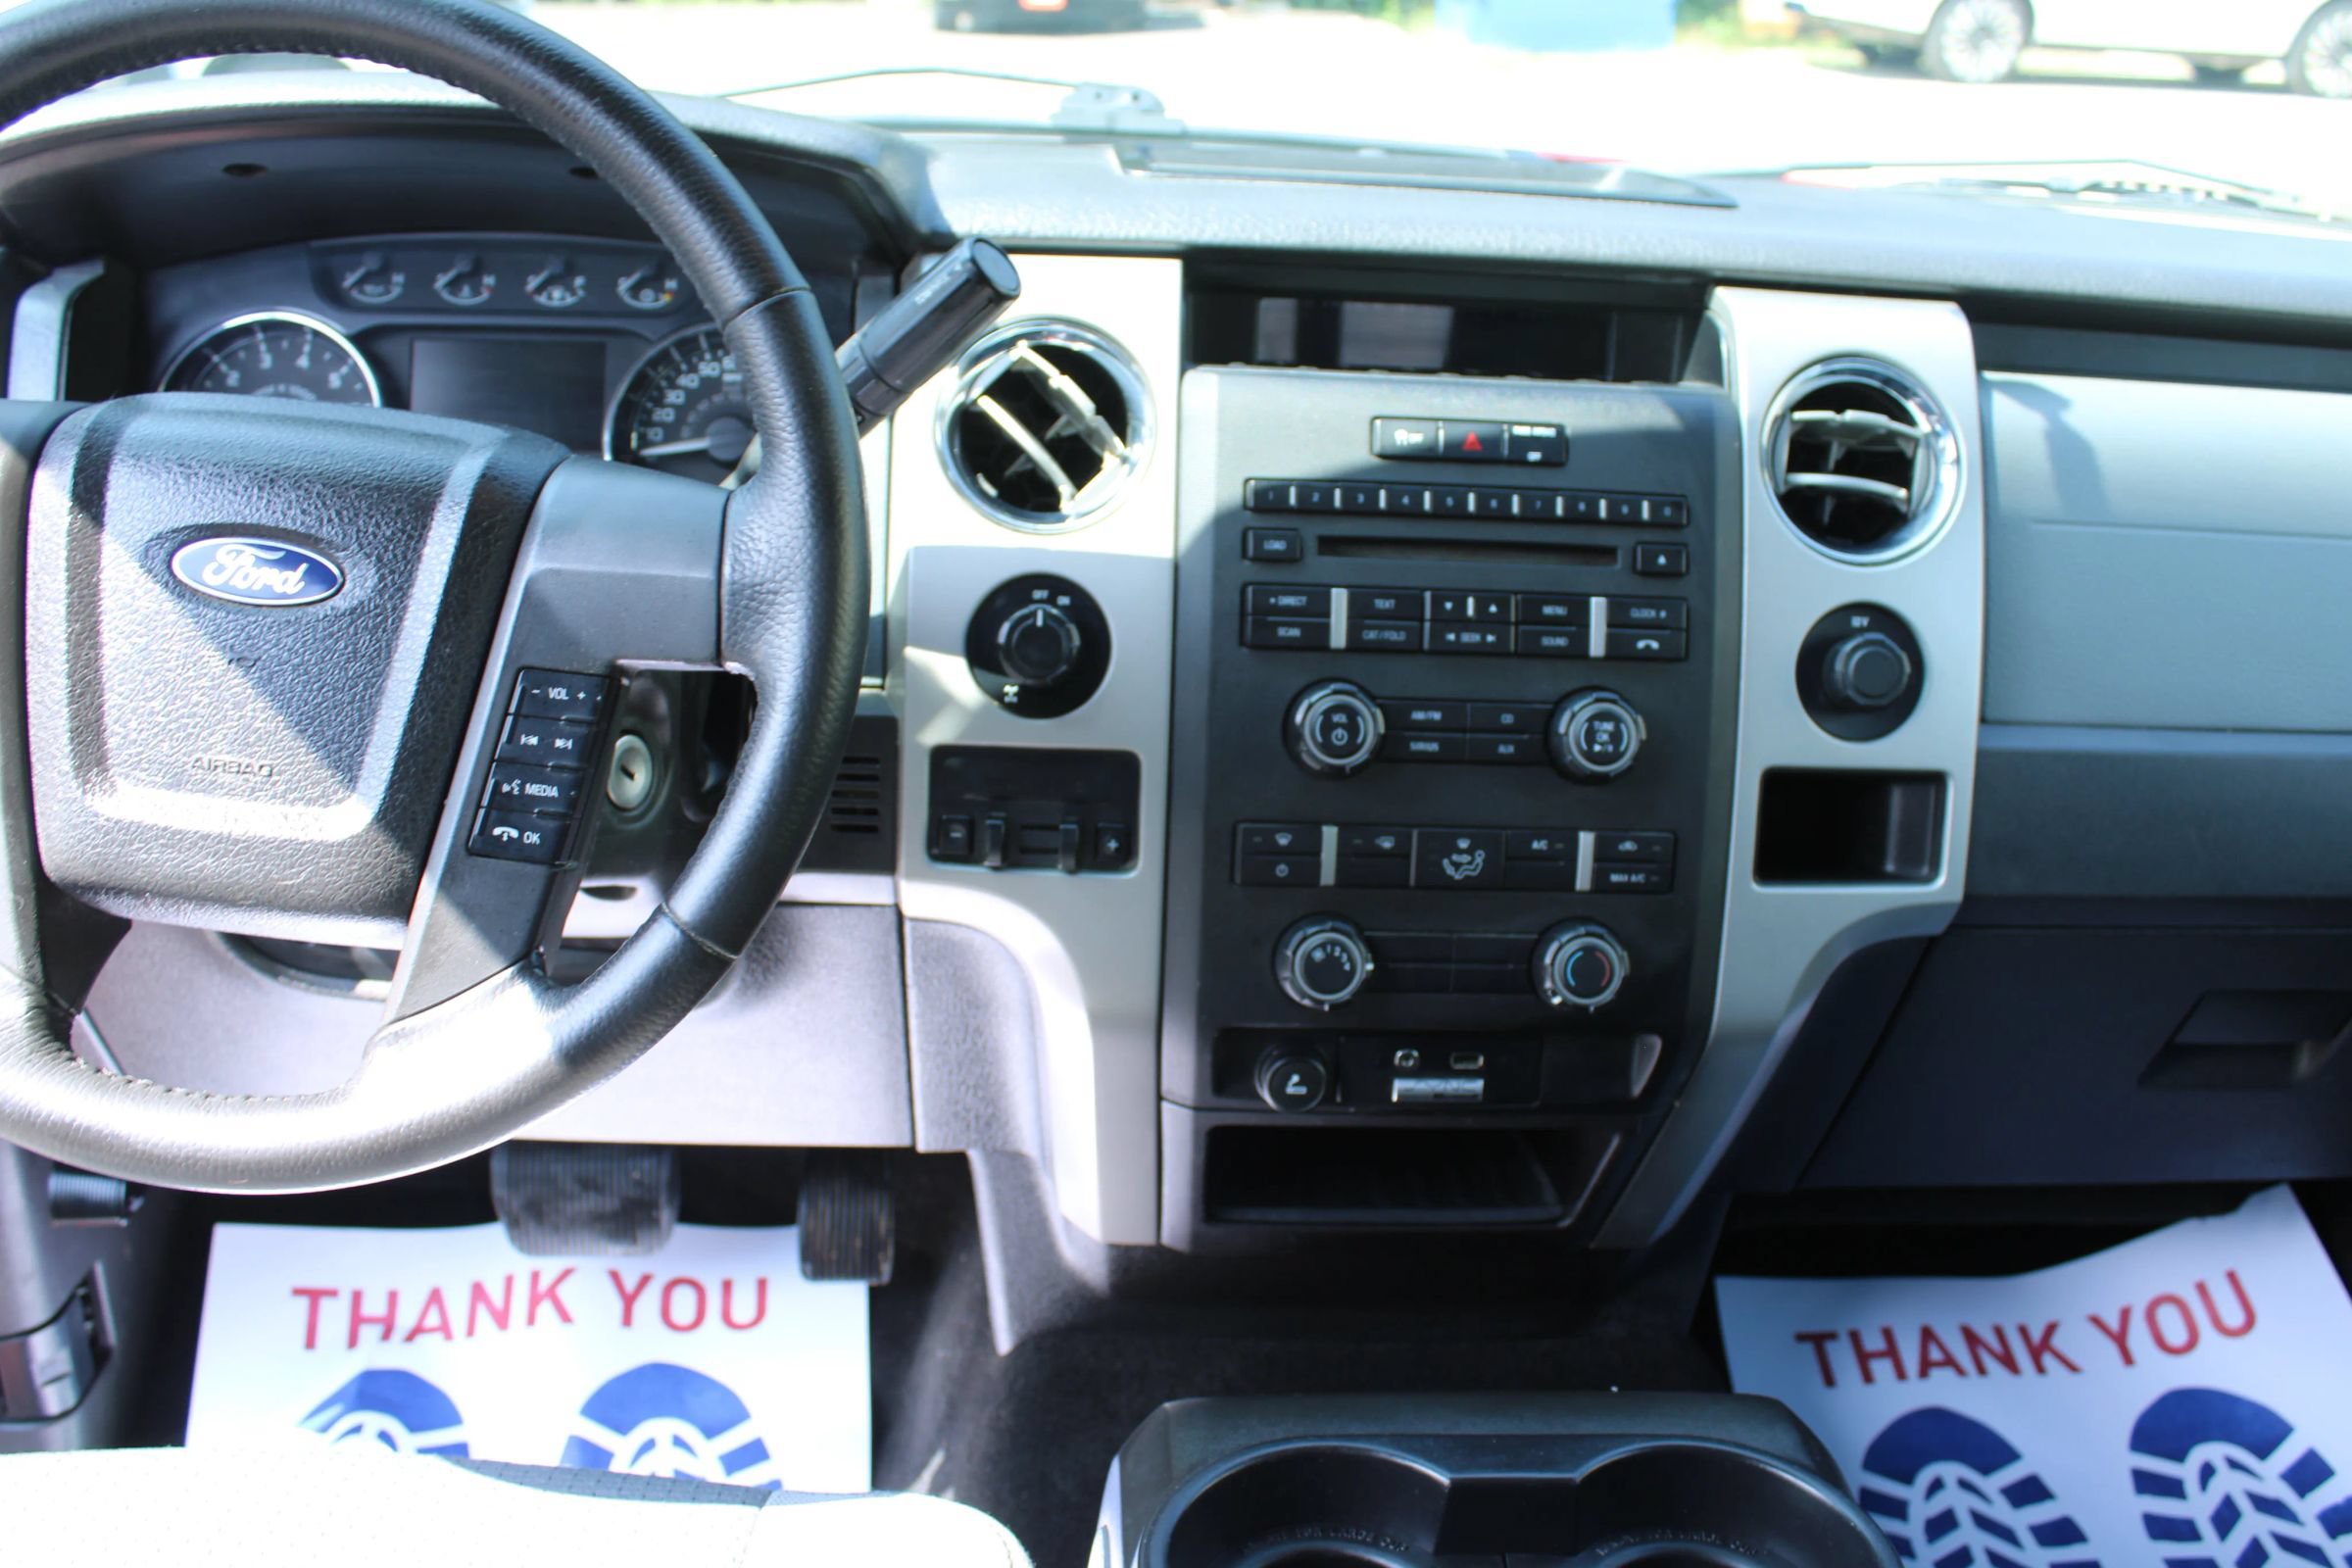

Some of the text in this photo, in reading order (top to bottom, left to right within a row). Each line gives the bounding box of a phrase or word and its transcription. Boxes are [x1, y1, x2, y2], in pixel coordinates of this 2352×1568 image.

[698, 361, 721, 377] 50
[675, 372, 700, 389] 40
[663, 389, 686, 405] 30
[652, 407, 675, 422] 20
[1263, 540, 1287, 551] LOAD
[202, 543, 309, 594] Ford
[1277, 596, 1307, 607] DIRECT
[1374, 599, 1396, 609] TEXT
[1542, 605, 1568, 615] MENU
[1630, 608, 1656, 618] CLOCK
[1277, 627, 1301, 637] SCAN
[1542, 636, 1569, 647] SOUND
[549, 687, 569, 700] VOL
[1332, 713, 1348, 723] VOL
[1411, 710, 1443, 721] AM/FM
[1593, 721, 1615, 732] TUNE
[191, 757, 273, 777] AIRBAG
[524, 783, 559, 798] MEDIA
[523, 831, 541, 845] OK
[1532, 839, 1548, 851] A/C
[291, 1267, 769, 1350] THANK YOU
[1794, 1269, 2258, 1389] THANK YOU
